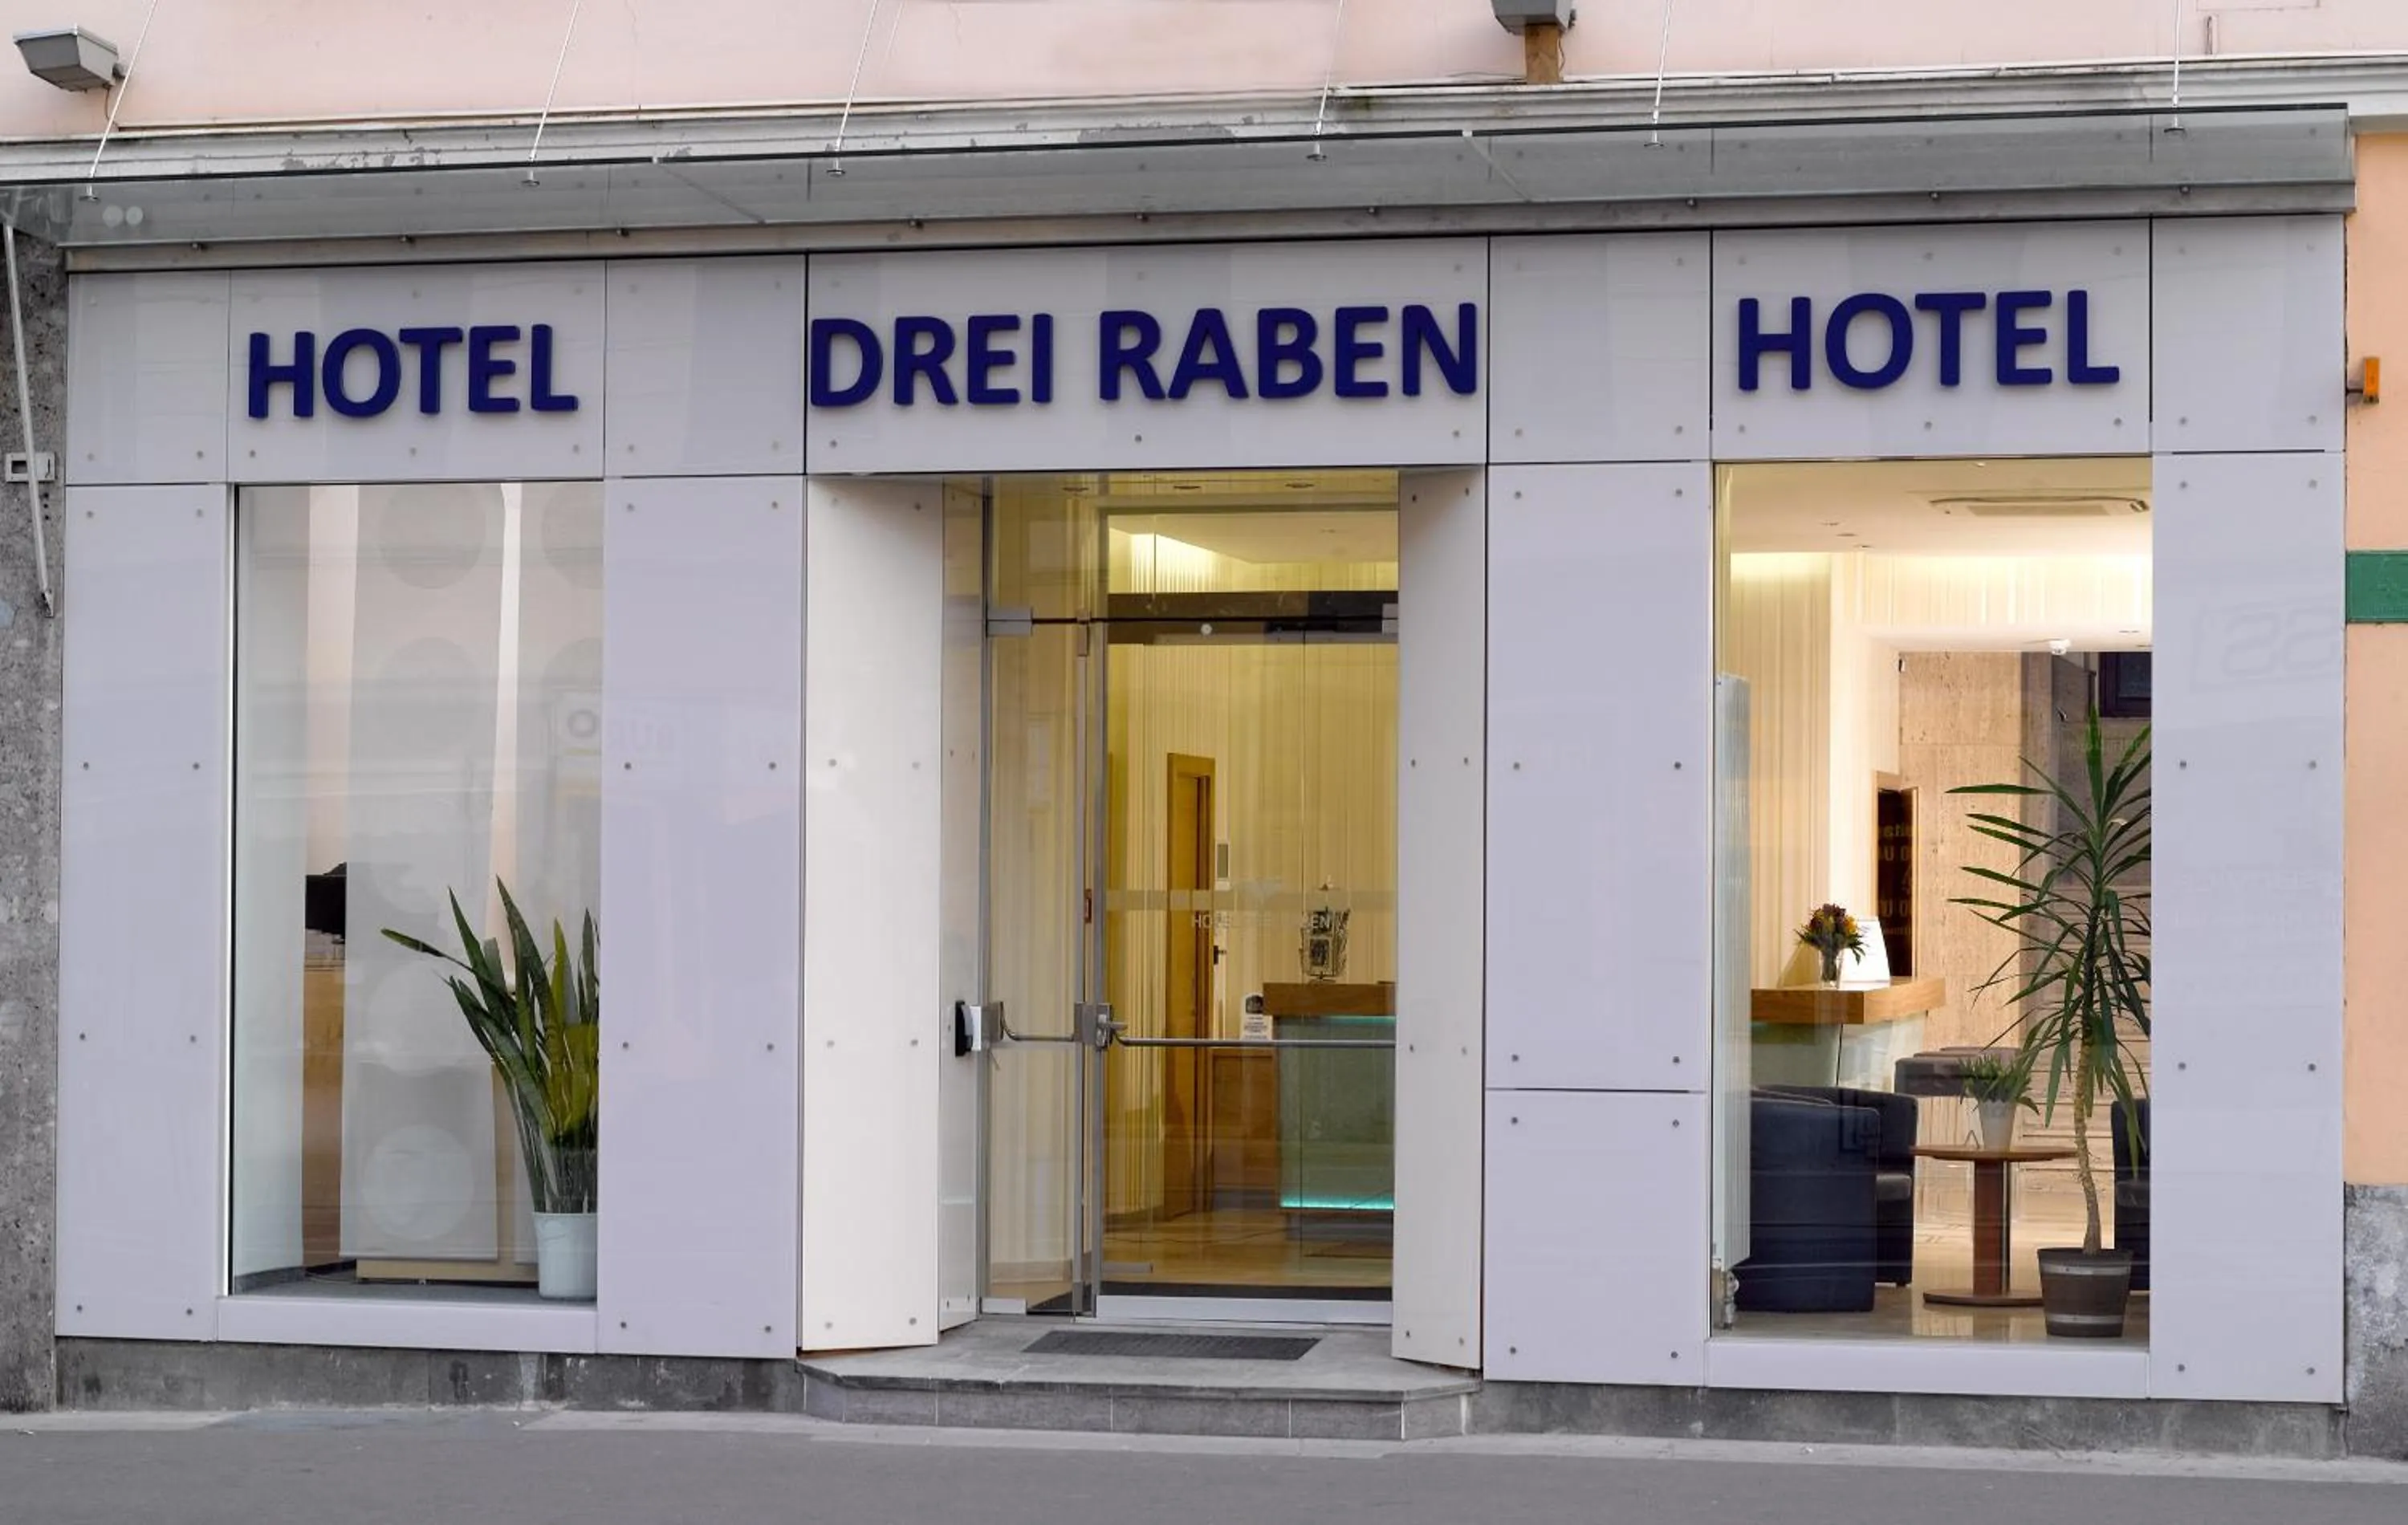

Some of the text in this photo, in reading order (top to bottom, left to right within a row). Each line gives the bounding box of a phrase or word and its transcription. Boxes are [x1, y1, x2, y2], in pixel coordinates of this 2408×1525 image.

[248, 323, 579, 418] HOTEL
[810, 303, 1478, 407] DREI RABEN
[1739, 290, 2120, 392] HOTEL
